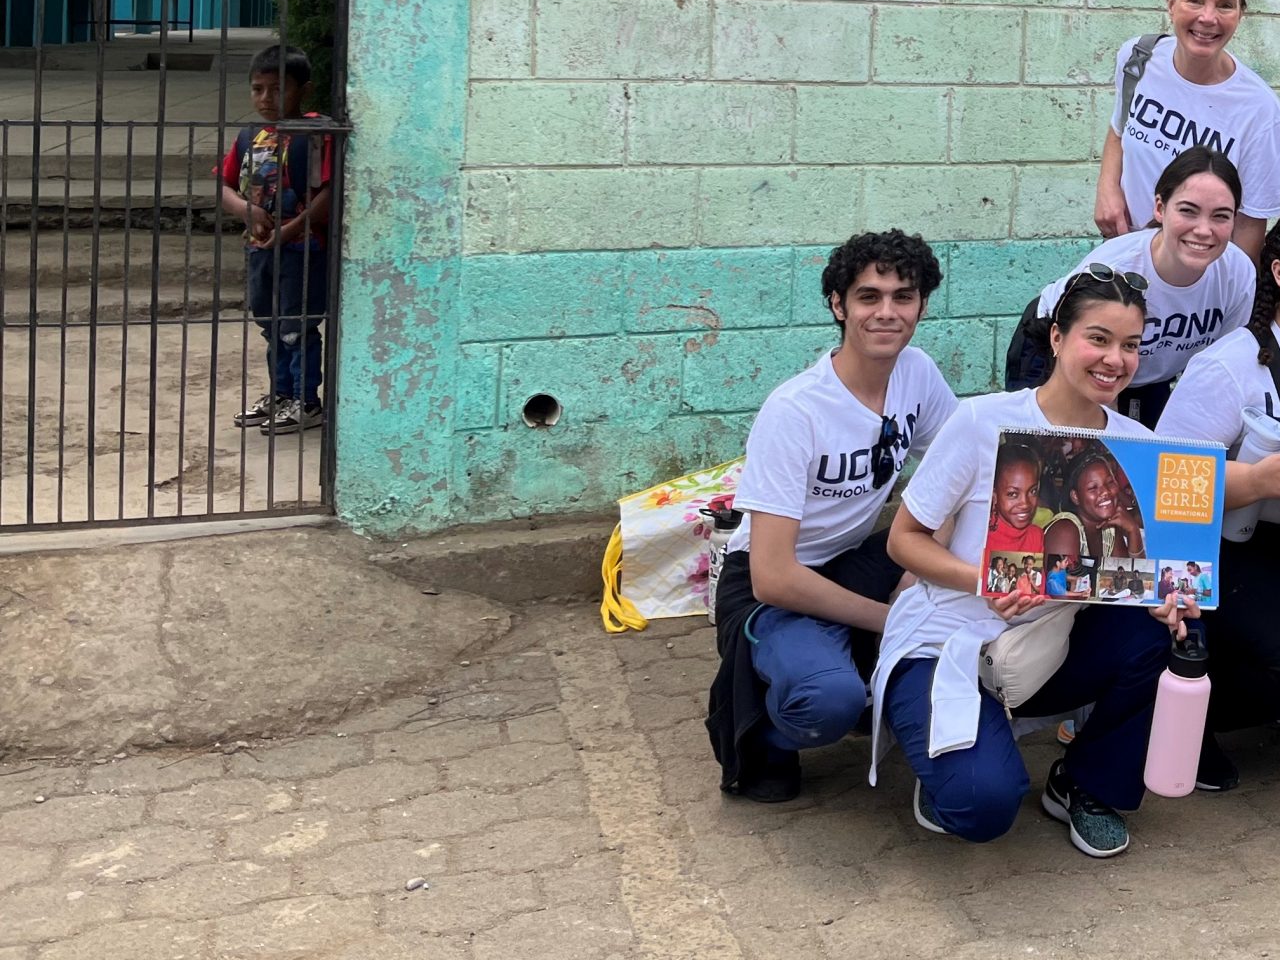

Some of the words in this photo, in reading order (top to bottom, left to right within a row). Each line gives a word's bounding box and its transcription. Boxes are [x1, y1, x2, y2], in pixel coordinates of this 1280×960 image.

[1154, 139, 1170, 152] OF
[1140, 308, 1224, 346] CONN
[1156, 341, 1173, 349] OF
[1162, 457, 1212, 477] DAYS
[1162, 477, 1189, 490] FOR
[812, 484, 869, 499] SCHOOL
[1160, 491, 1210, 508] GIRLS
[1160, 509, 1208, 518] INTERNATIONAL
